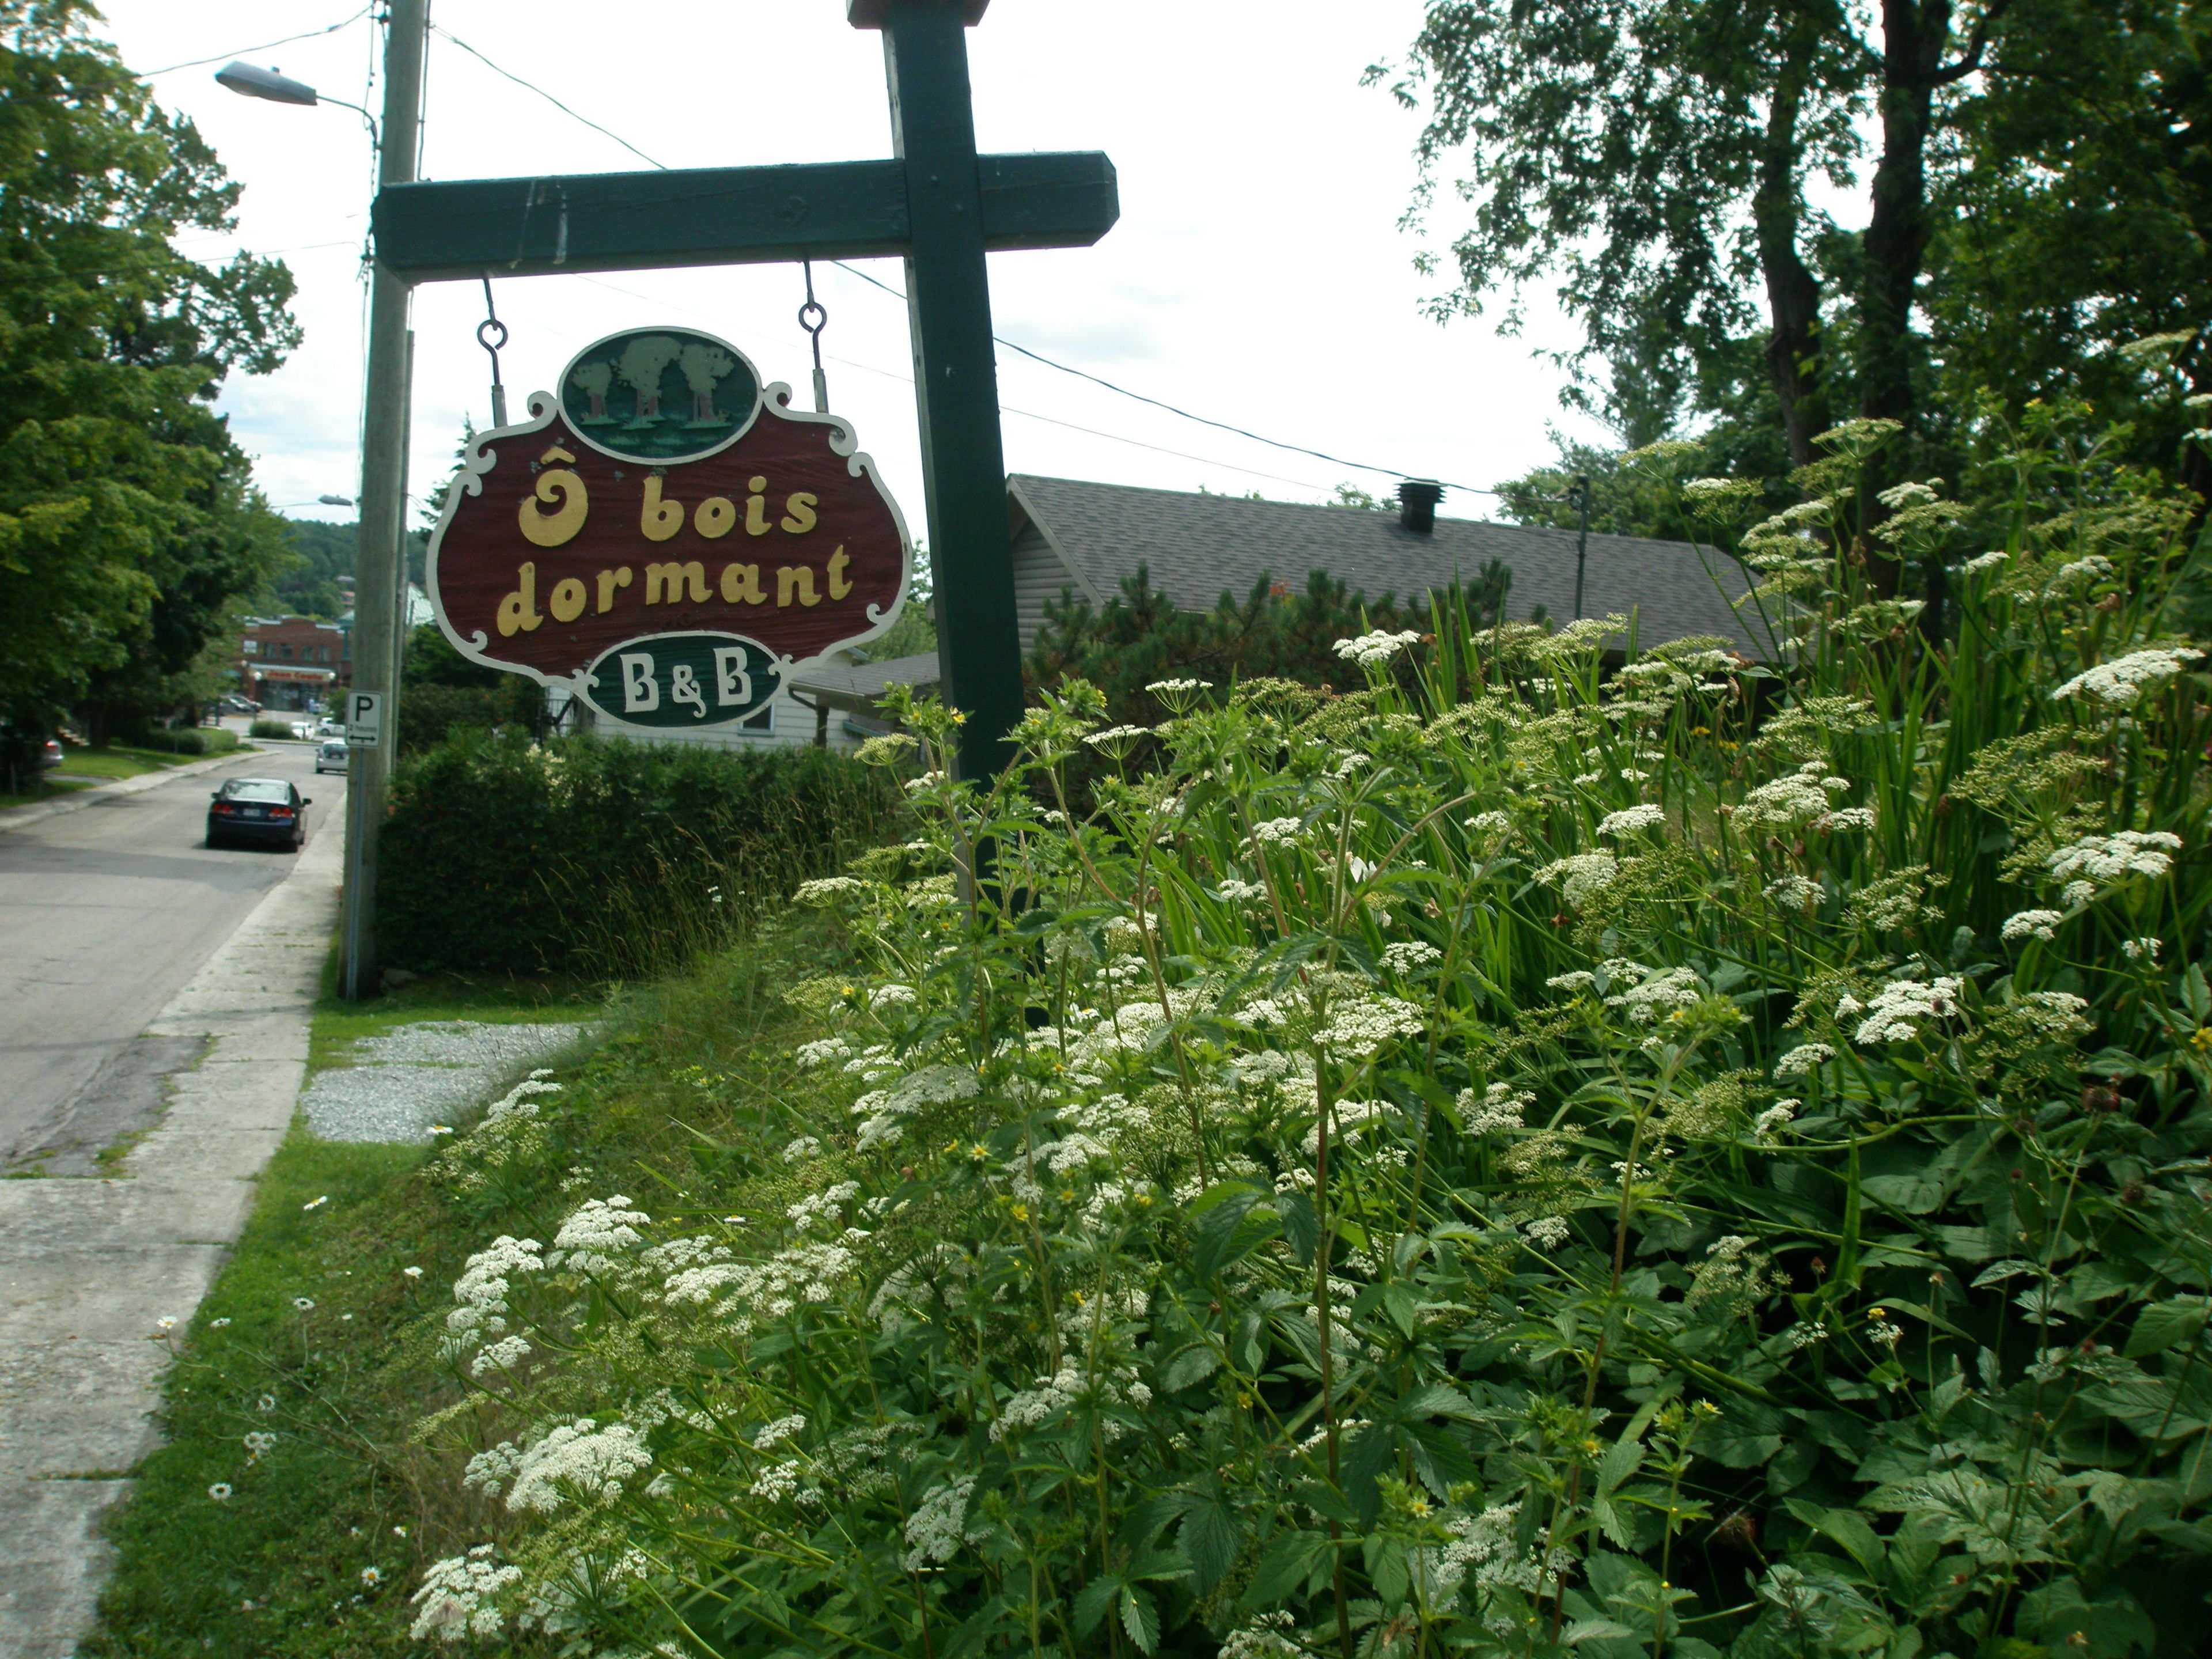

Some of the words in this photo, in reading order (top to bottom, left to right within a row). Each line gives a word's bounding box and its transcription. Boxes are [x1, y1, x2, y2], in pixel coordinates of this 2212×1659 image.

[518, 446, 589, 547] Ô
[640, 475, 818, 541] bois
[497, 544, 853, 638] dormant
[356, 696, 373, 721] P
